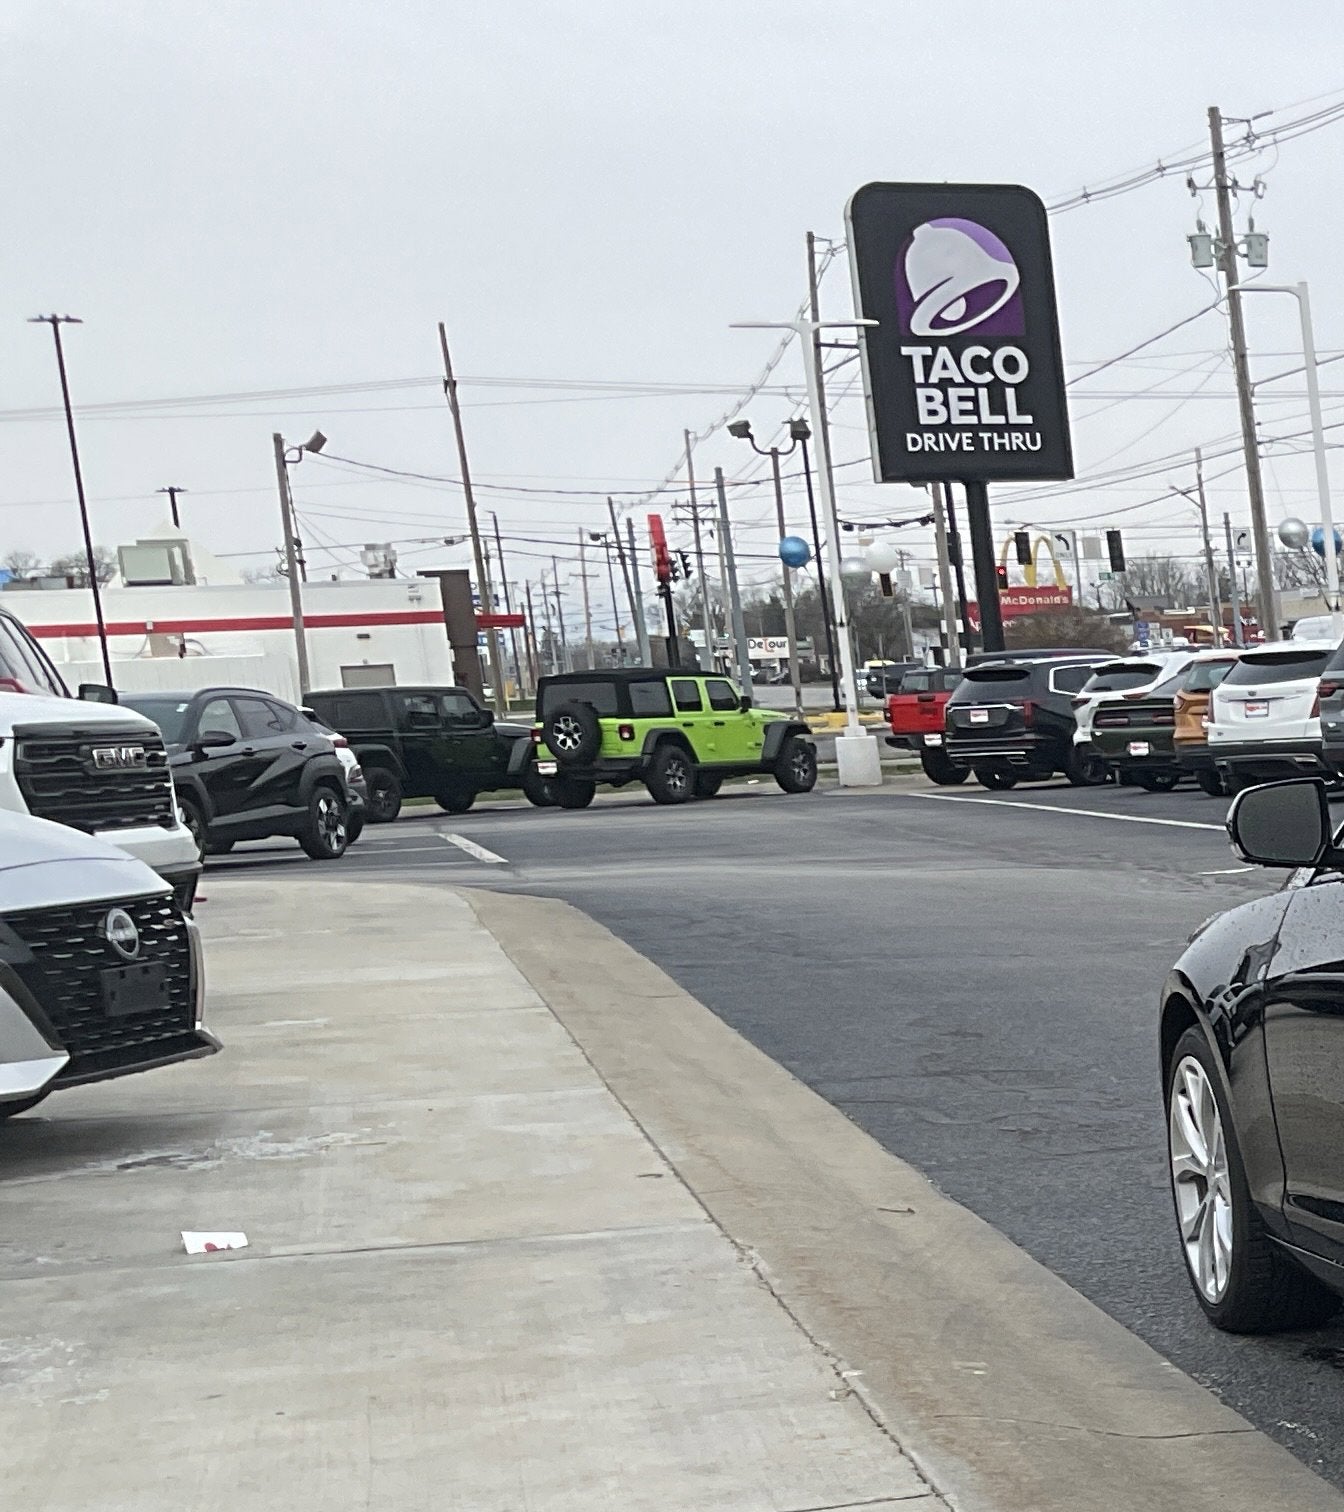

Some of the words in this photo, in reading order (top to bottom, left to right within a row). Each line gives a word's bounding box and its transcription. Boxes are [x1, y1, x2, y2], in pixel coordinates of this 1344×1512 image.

[901, 346, 1029, 384] TACO
[916, 387, 1033, 425] BELL
[906, 432, 975, 451] DRIVE
[978, 432, 1041, 451] THRU
[1001, 595, 1069, 605] McDonald's
[93, 747, 145, 769] GMC
